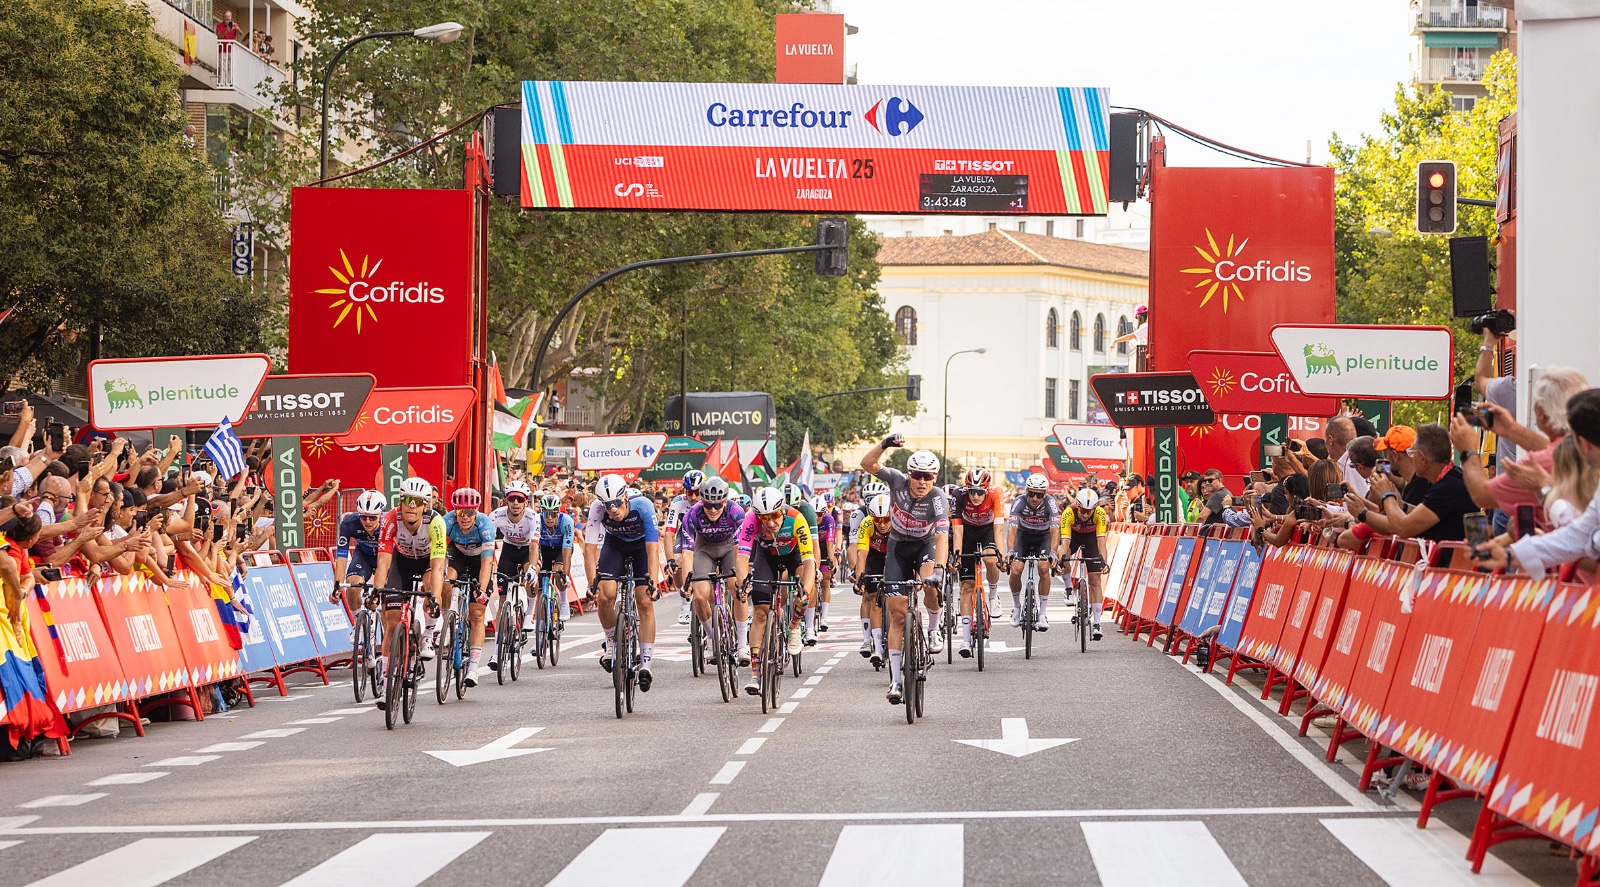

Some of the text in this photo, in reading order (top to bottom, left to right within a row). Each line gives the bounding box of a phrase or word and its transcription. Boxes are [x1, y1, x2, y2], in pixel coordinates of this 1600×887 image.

[785, 43, 834, 56] LA VUELTA
[706, 102, 851, 129] Carrefour
[614, 157, 632, 166] UCI
[755, 157, 875, 179] LA VUELTA 25
[957, 160, 1015, 172] TISSOT
[953, 176, 995, 184] LA VUELTA
[796, 188, 833, 200] ZARAGOZA
[950, 185, 998, 194] ZARAGOZA
[923, 196, 1024, 208] 3:43:48 +1
[1215, 258, 1312, 283] Cofidis
[348, 280, 445, 304] Cofidis
[1346, 353, 1439, 373] plenitude
[1240, 371, 1300, 393] Cofi
[148, 383, 239, 406] plenitude
[260, 391, 345, 411] TISSOT
[1140, 388, 1207, 405] TISSOT
[256, 411, 297, 420] WATCHES
[299, 410, 326, 418] SINCE
[327, 409, 347, 417] 1853
[373, 404, 454, 425] Cofidis
[692, 428, 725, 437] Frtiberia
[1065, 436, 1114, 447] Carrefour
[582, 447, 632, 459] Carrefour
[895, 509, 923, 527] Alpecin
[63, 620, 100, 661] VUELTA
[1548, 671, 1600, 749] VUELTA
